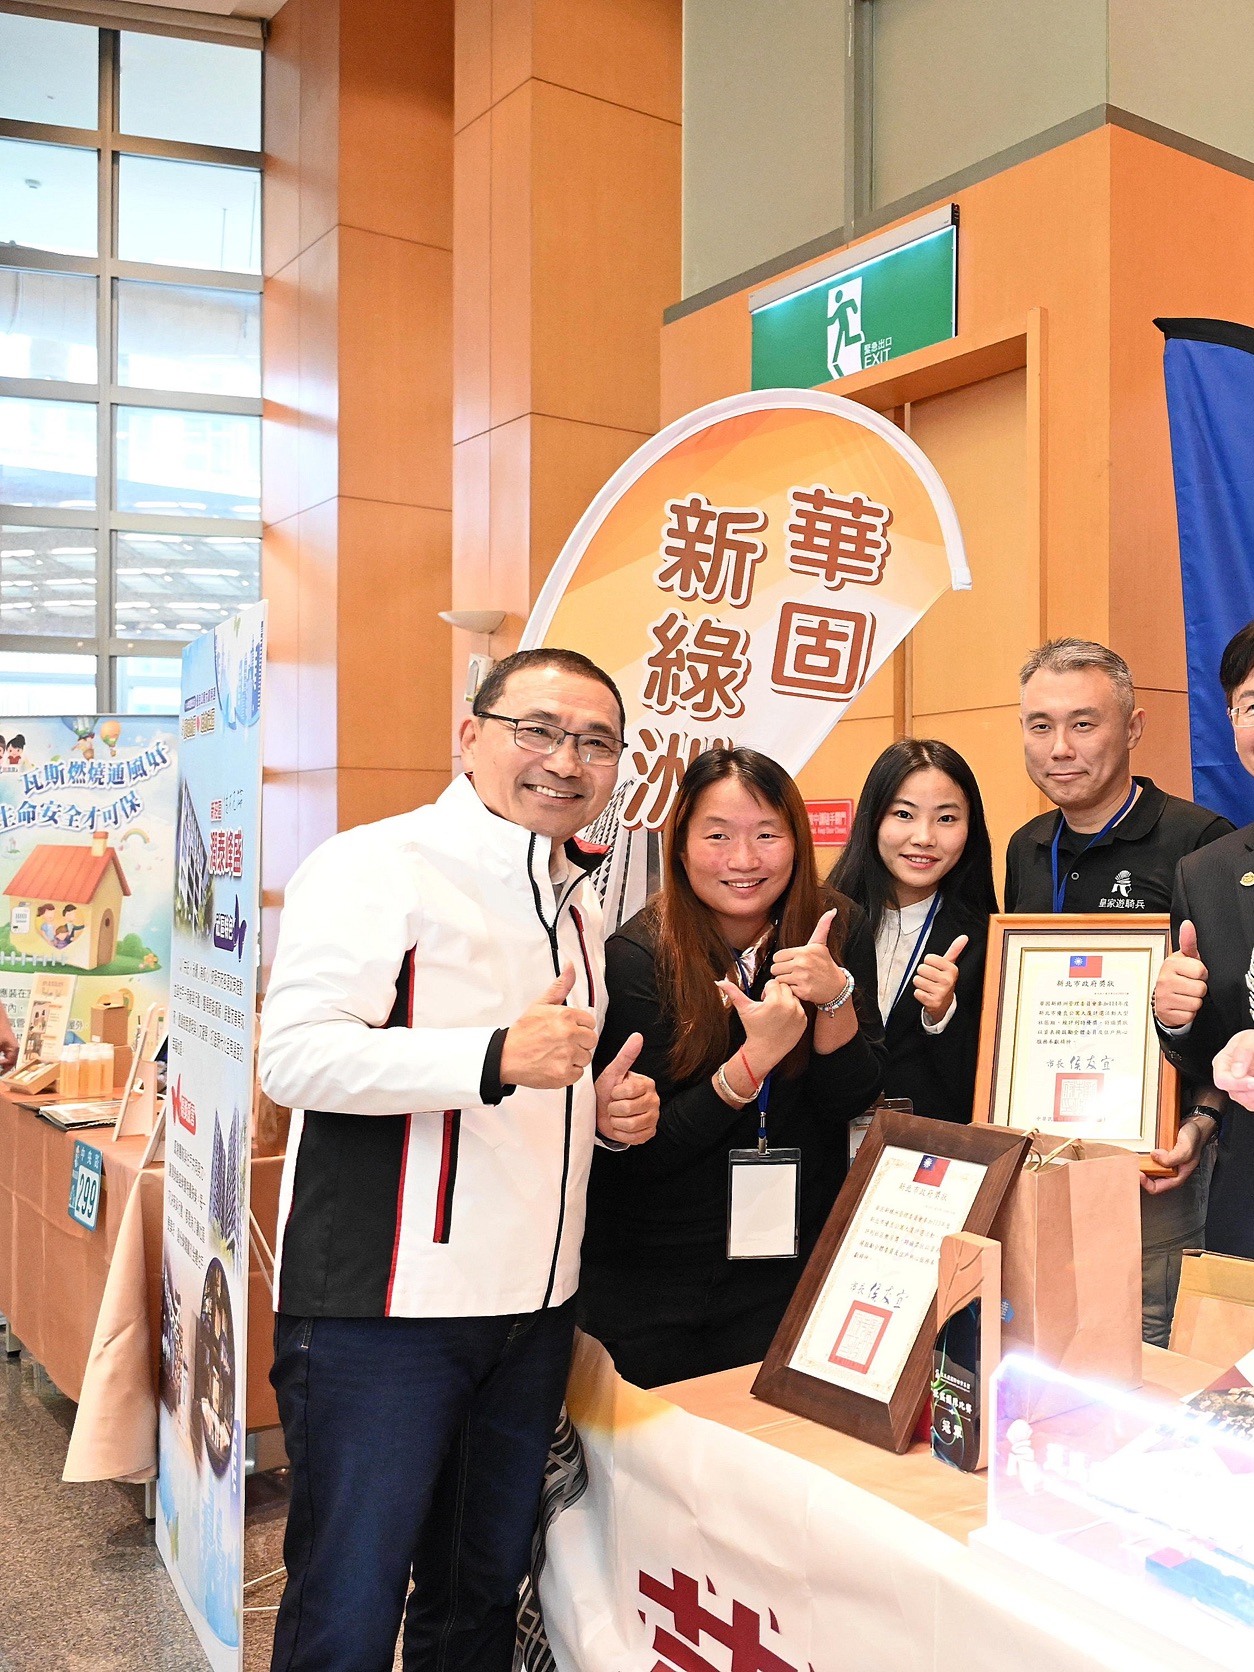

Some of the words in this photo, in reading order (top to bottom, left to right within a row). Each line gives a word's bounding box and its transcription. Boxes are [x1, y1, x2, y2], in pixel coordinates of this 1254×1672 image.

[864, 337, 892, 355] 緊急出口
[864, 348, 890, 369] EXIT
[771, 487, 892, 702] 華固
[22, 741, 169, 796] 瓦斯燃燒通風好
[0, 790, 142, 830] 生命安全才可保
[1098, 898, 1146, 910] 皇家遊騎兵
[75, 1172, 97, 1219] 299
